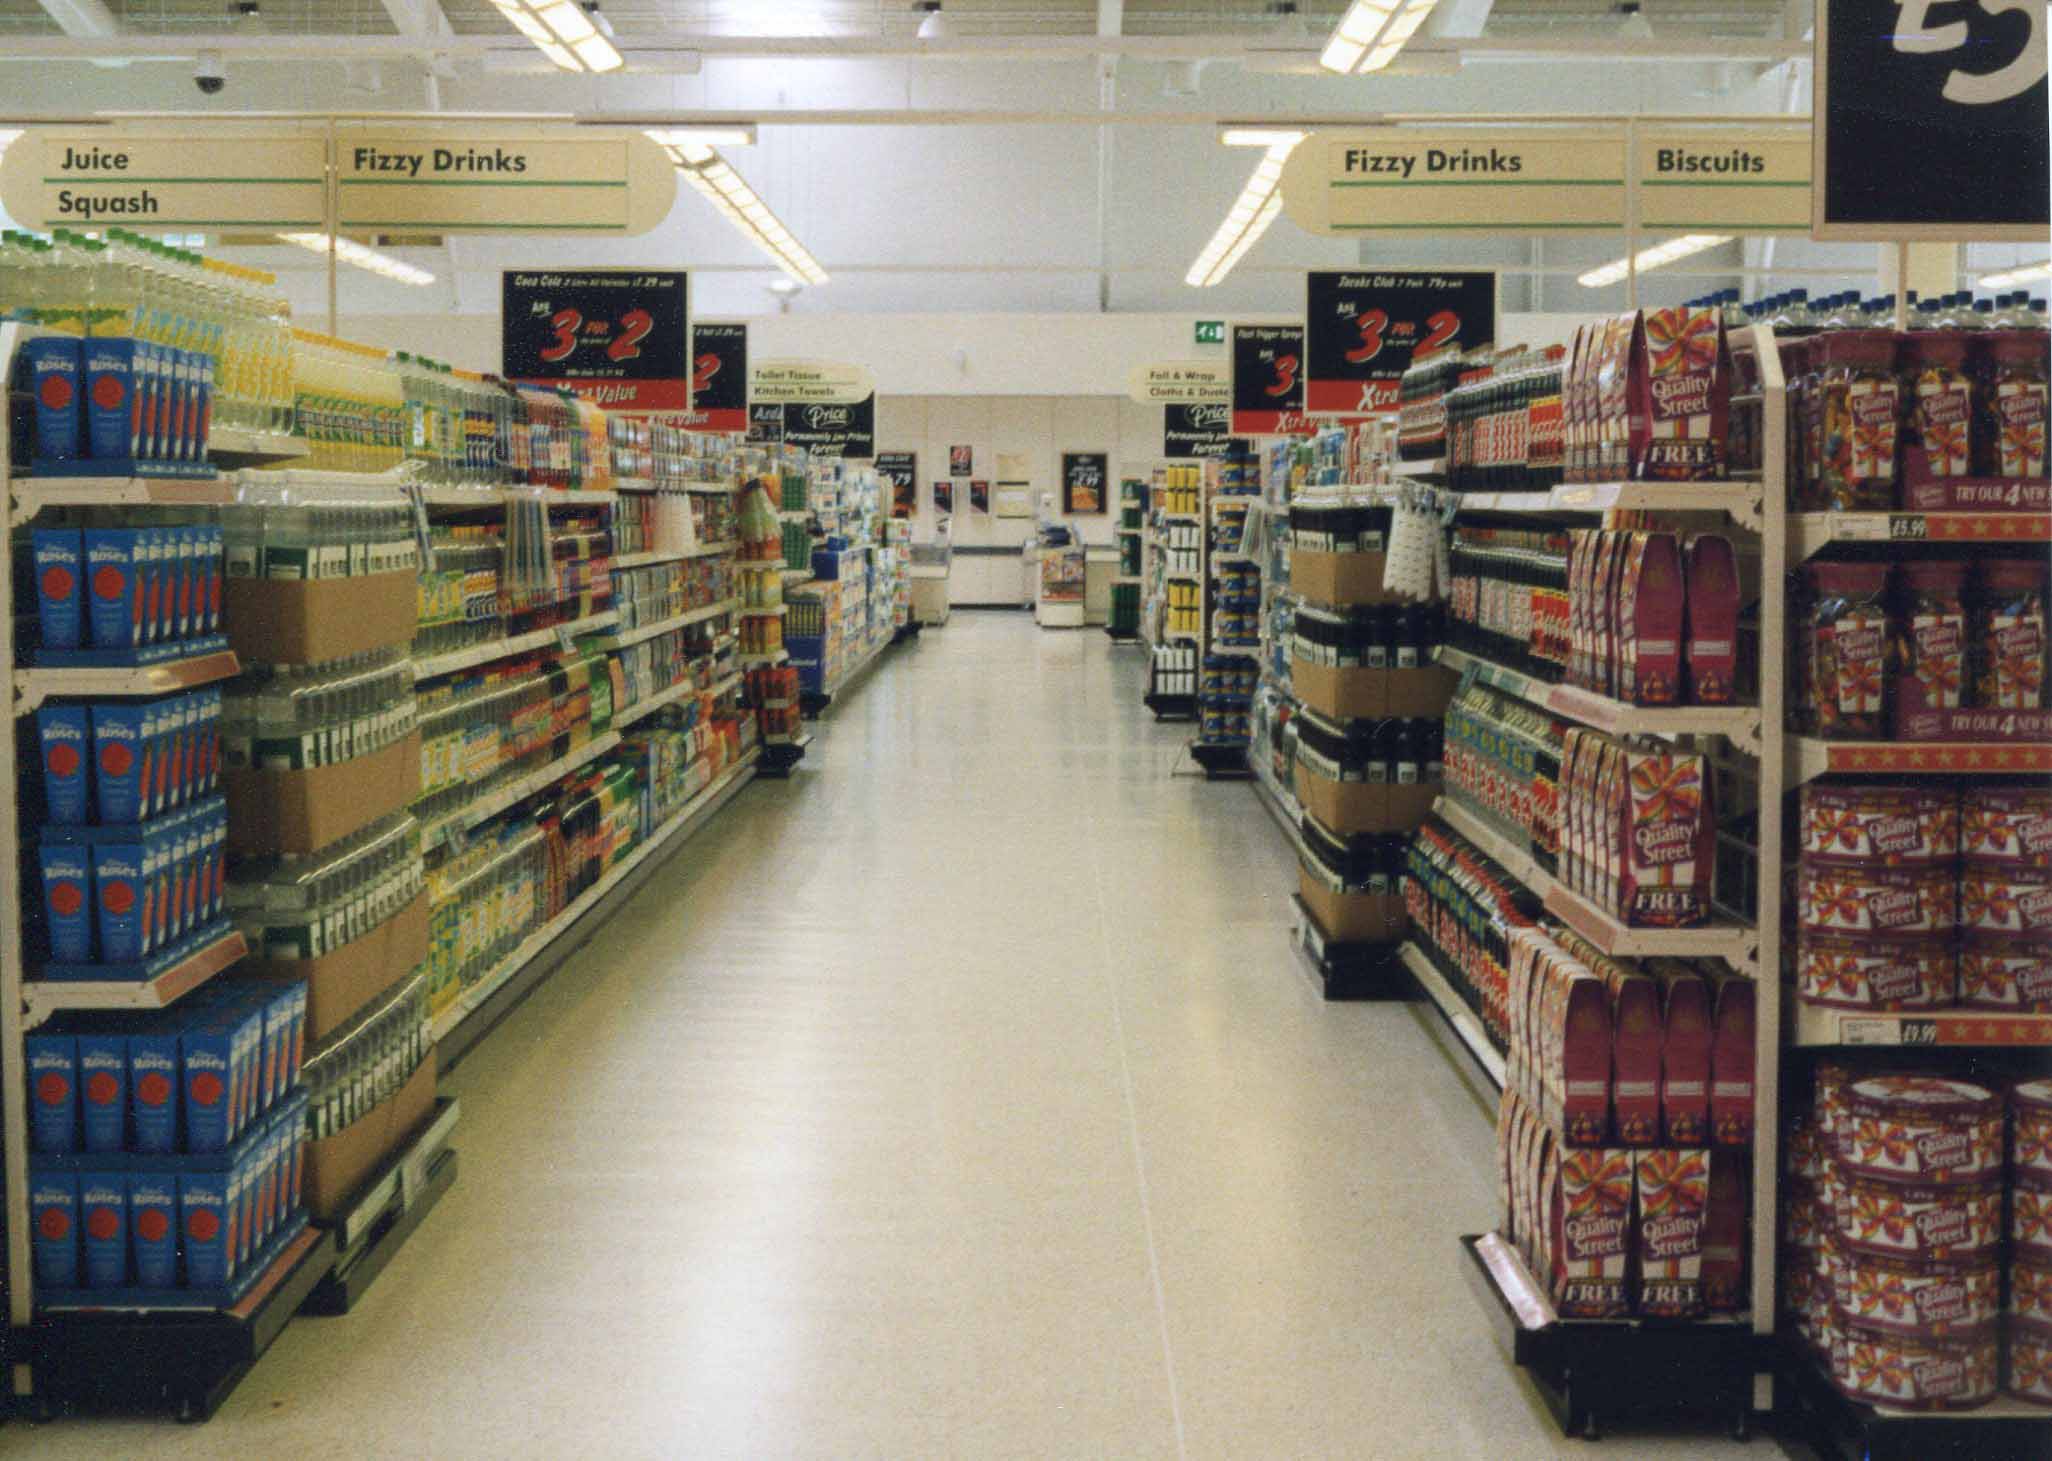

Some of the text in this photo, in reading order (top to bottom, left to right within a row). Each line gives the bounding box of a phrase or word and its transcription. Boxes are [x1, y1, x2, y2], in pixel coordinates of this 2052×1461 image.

[62, 147, 129, 170] Juice
[354, 147, 526, 177] Fizzy Drinks
[1346, 148, 1522, 178] Fizzy Drinks
[1657, 149, 1764, 173] Biscuits
[59, 190, 158, 219] Squash
[541, 308, 654, 363] 3 FOR 2
[1345, 308, 1461, 363] 3 FOR 2
[693, 353, 721, 394] 2
[754, 371, 821, 380] Toilet Tissue
[1149, 371, 1217, 383] Foil & Wrap
[1264, 353, 1299, 397] 3
[596, 384, 638, 406] Value
[754, 387, 836, 397] Kitchen Towels
[1651, 375, 1712, 401] Quality
[808, 406, 848, 430] Price
[1657, 398, 1710, 418] Street
[1650, 446, 1709, 463] FREE
[1977, 485, 2003, 502] OUR
[2003, 483, 2022, 507] 4
[1973, 714, 1996, 732] OUR
[1999, 713, 2016, 735] 4
[1634, 824, 1694, 848] Quality
[1642, 843, 1693, 864] Street
[1635, 892, 1693, 911] FREE
[1917, 1132, 1969, 1152] Quality
[1565, 1218, 1625, 1241] Quality
[1641, 1218, 1700, 1241] Quality
[1573, 1235, 1625, 1255] Street
[1649, 1235, 1700, 1255] Street
[1566, 1284, 1625, 1302] FREE
[1641, 1284, 1699, 1302] FREE
